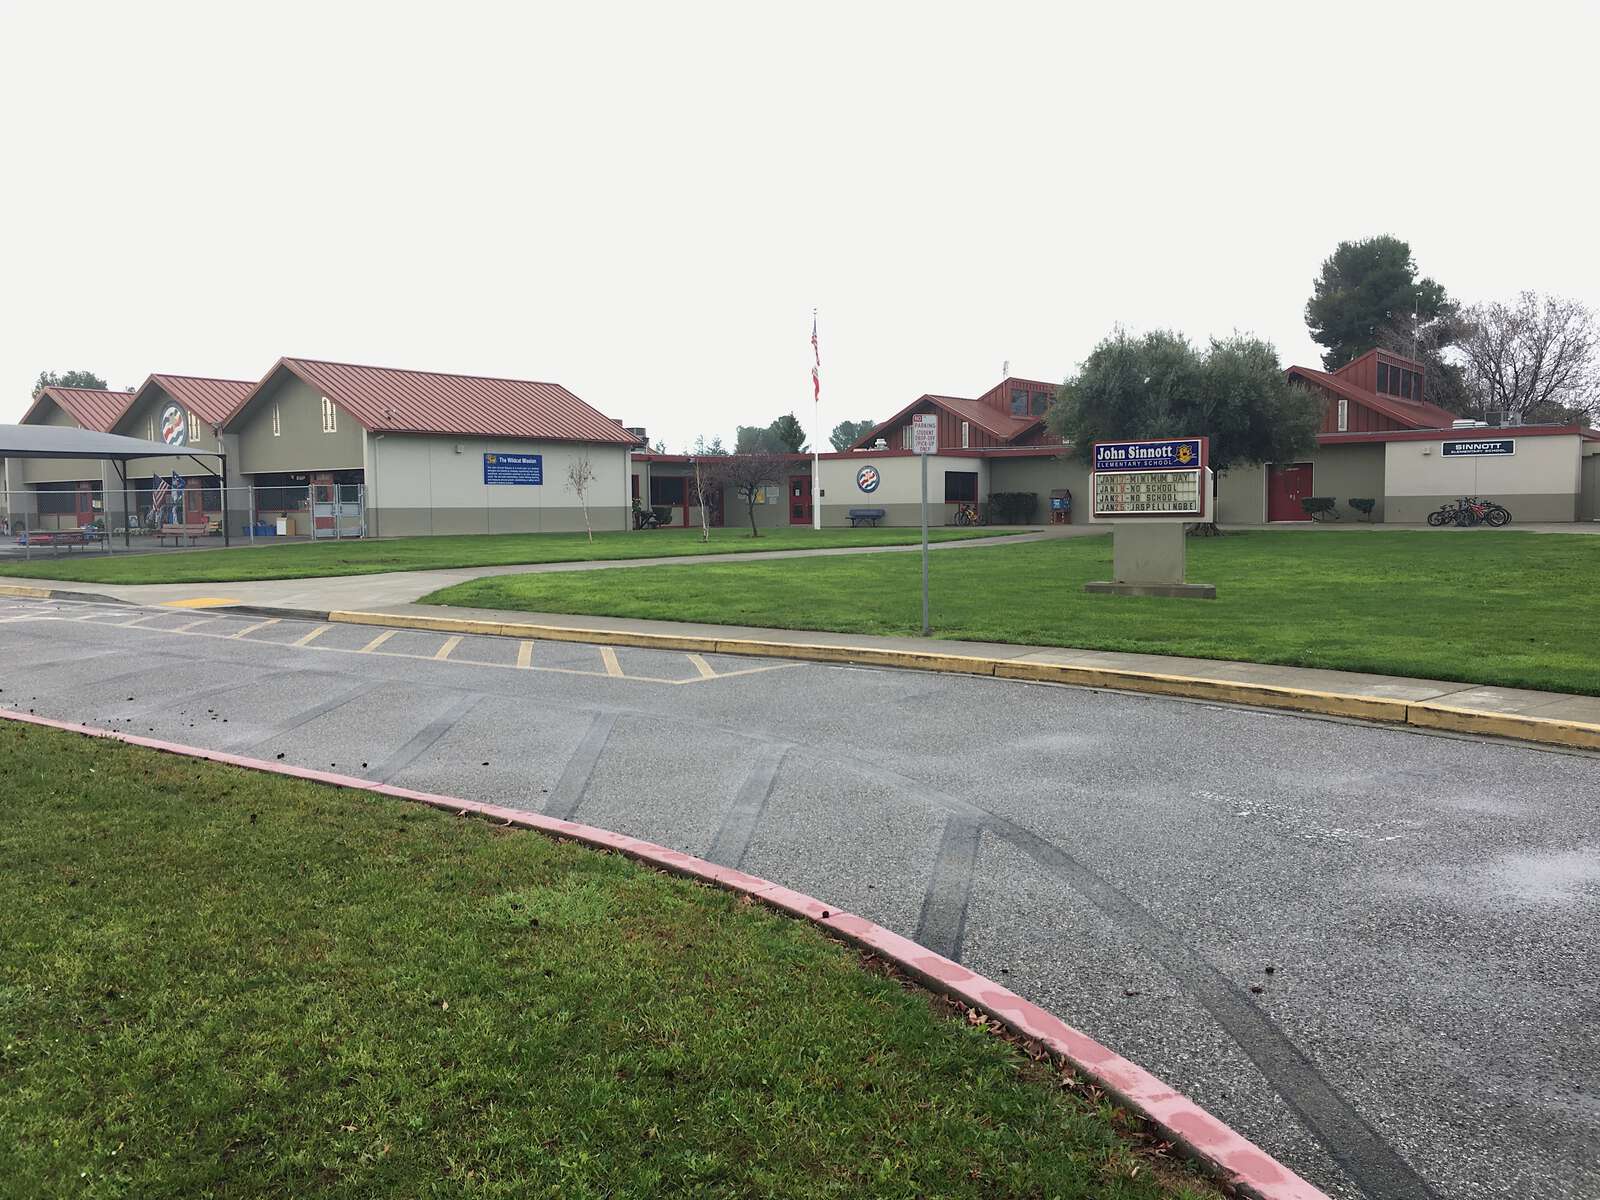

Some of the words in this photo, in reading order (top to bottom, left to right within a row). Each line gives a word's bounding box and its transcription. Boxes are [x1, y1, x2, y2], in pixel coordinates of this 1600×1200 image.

[1097, 447, 1125, 460] John
[1128, 445, 1173, 459] Sinnott
[1172, 473, 1188, 482] DAY
[1146, 484, 1177, 492] SCHOOL
